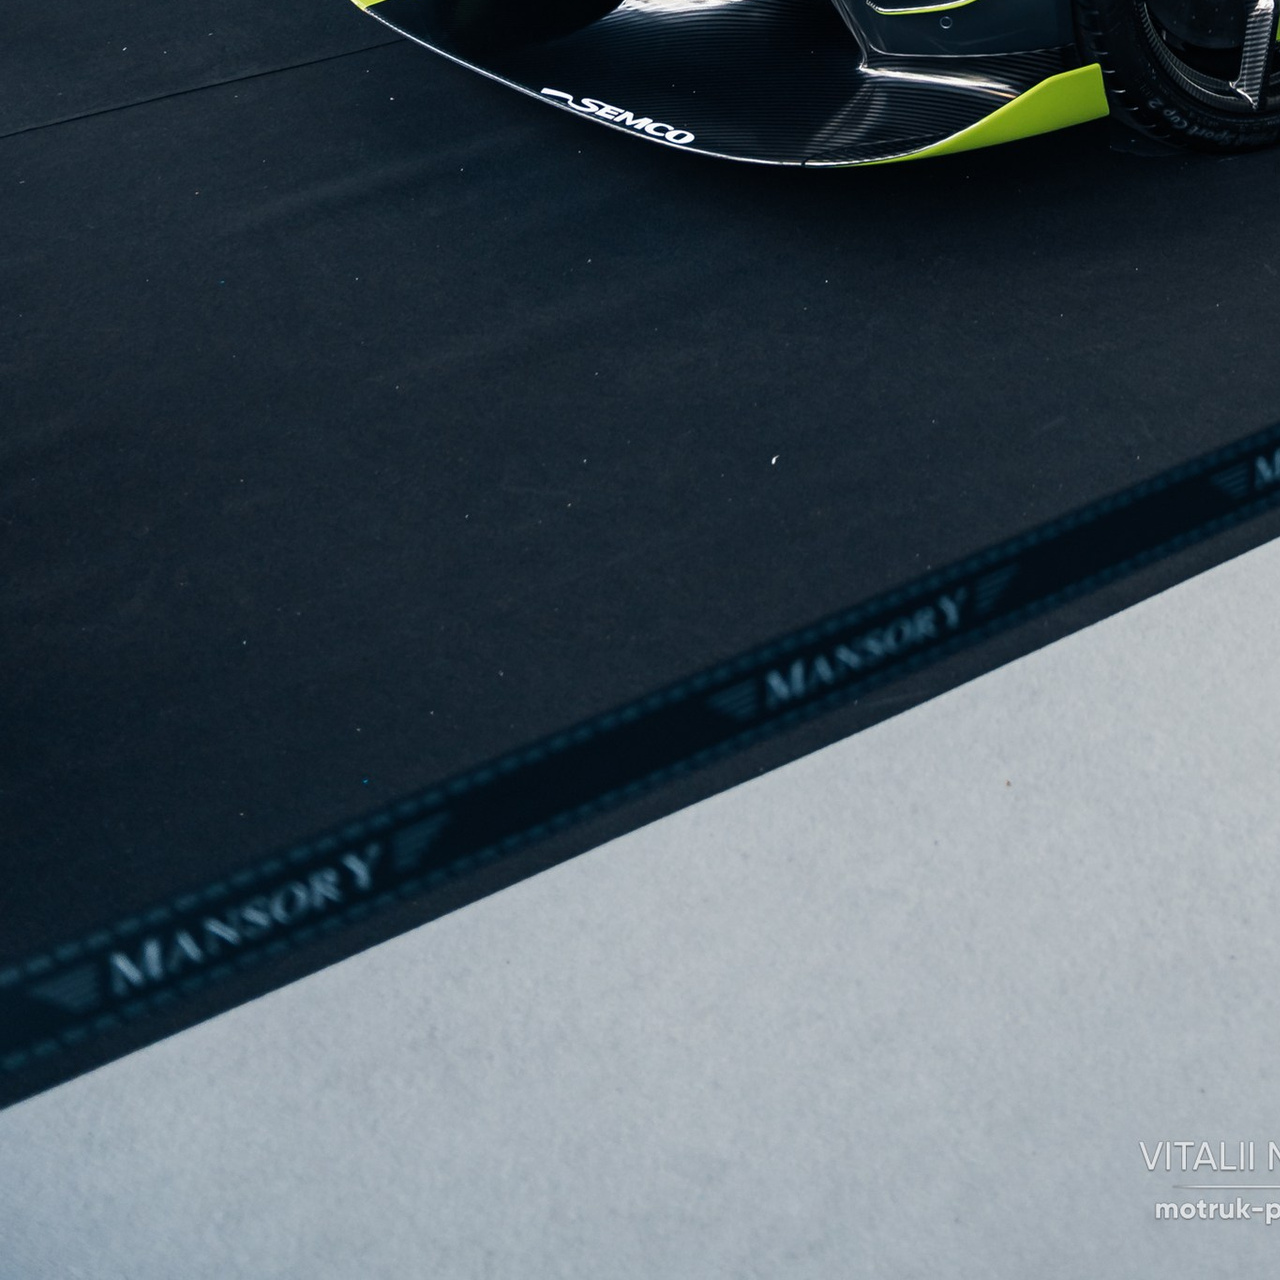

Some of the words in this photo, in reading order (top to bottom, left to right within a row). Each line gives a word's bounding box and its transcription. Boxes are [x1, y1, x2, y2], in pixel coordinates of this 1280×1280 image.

[541, 87, 695, 144] SEMCO
[763, 588, 967, 709] MANSORY
[107, 844, 382, 998] MANSORY
